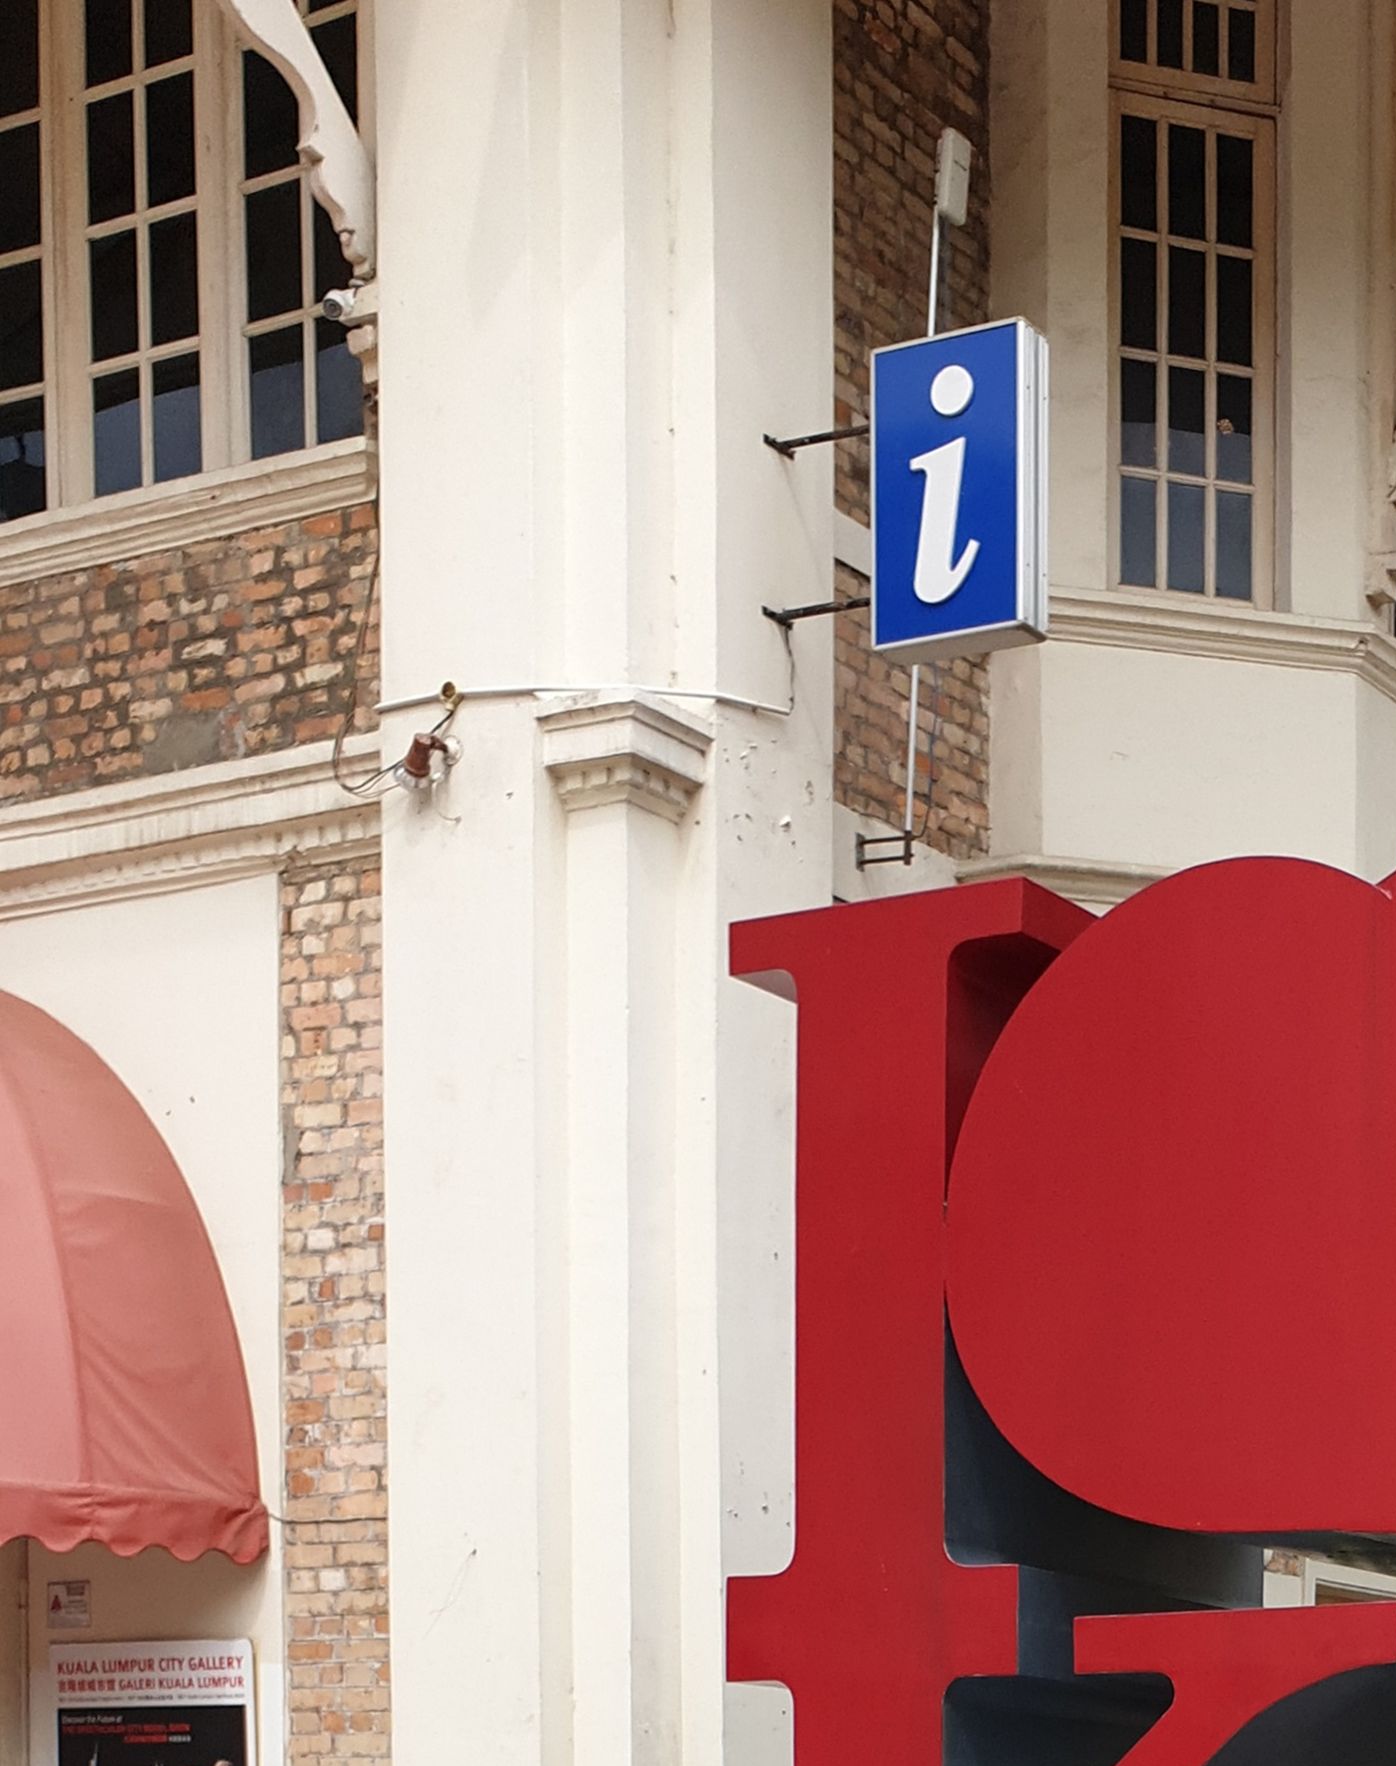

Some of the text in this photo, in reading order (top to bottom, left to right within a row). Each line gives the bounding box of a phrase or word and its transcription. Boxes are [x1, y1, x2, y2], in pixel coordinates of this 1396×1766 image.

[57, 1656, 244, 1675] KUALA LUMPUR CITY GALLERY
[119, 1679, 156, 1691] GALERI
[159, 1677, 195, 1690] KUALA
[198, 1675, 244, 1688] LUMPUR
